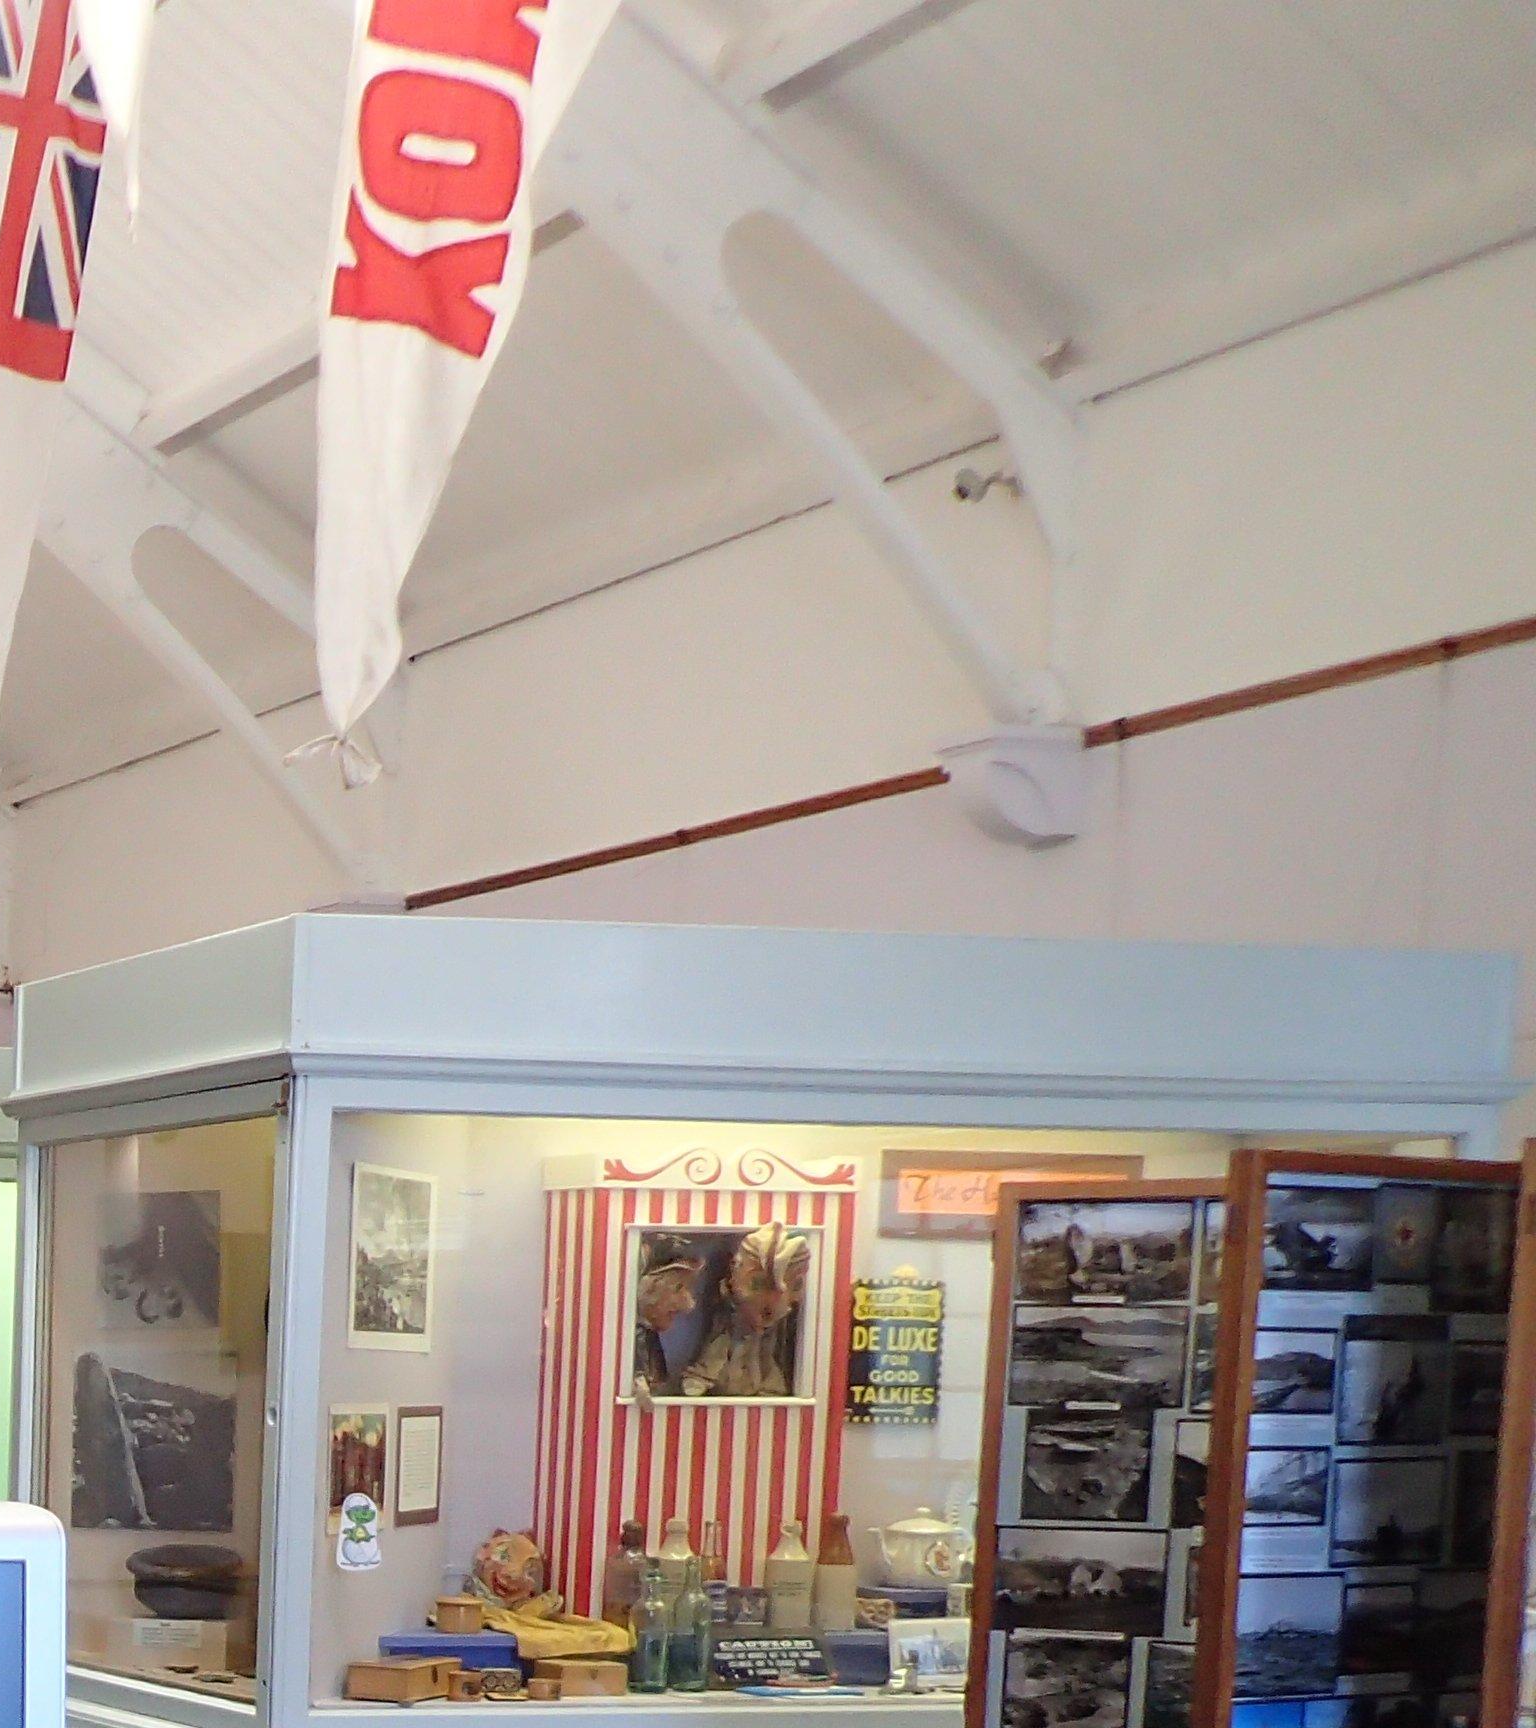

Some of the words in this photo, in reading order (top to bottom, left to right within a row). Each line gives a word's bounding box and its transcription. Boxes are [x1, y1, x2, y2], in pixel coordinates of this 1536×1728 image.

[852, 1326, 881, 1351] DE
[887, 1326, 939, 1352] LUXE
[869, 1370, 919, 1383] GOOD
[850, 1385, 935, 1405] TALKIES
